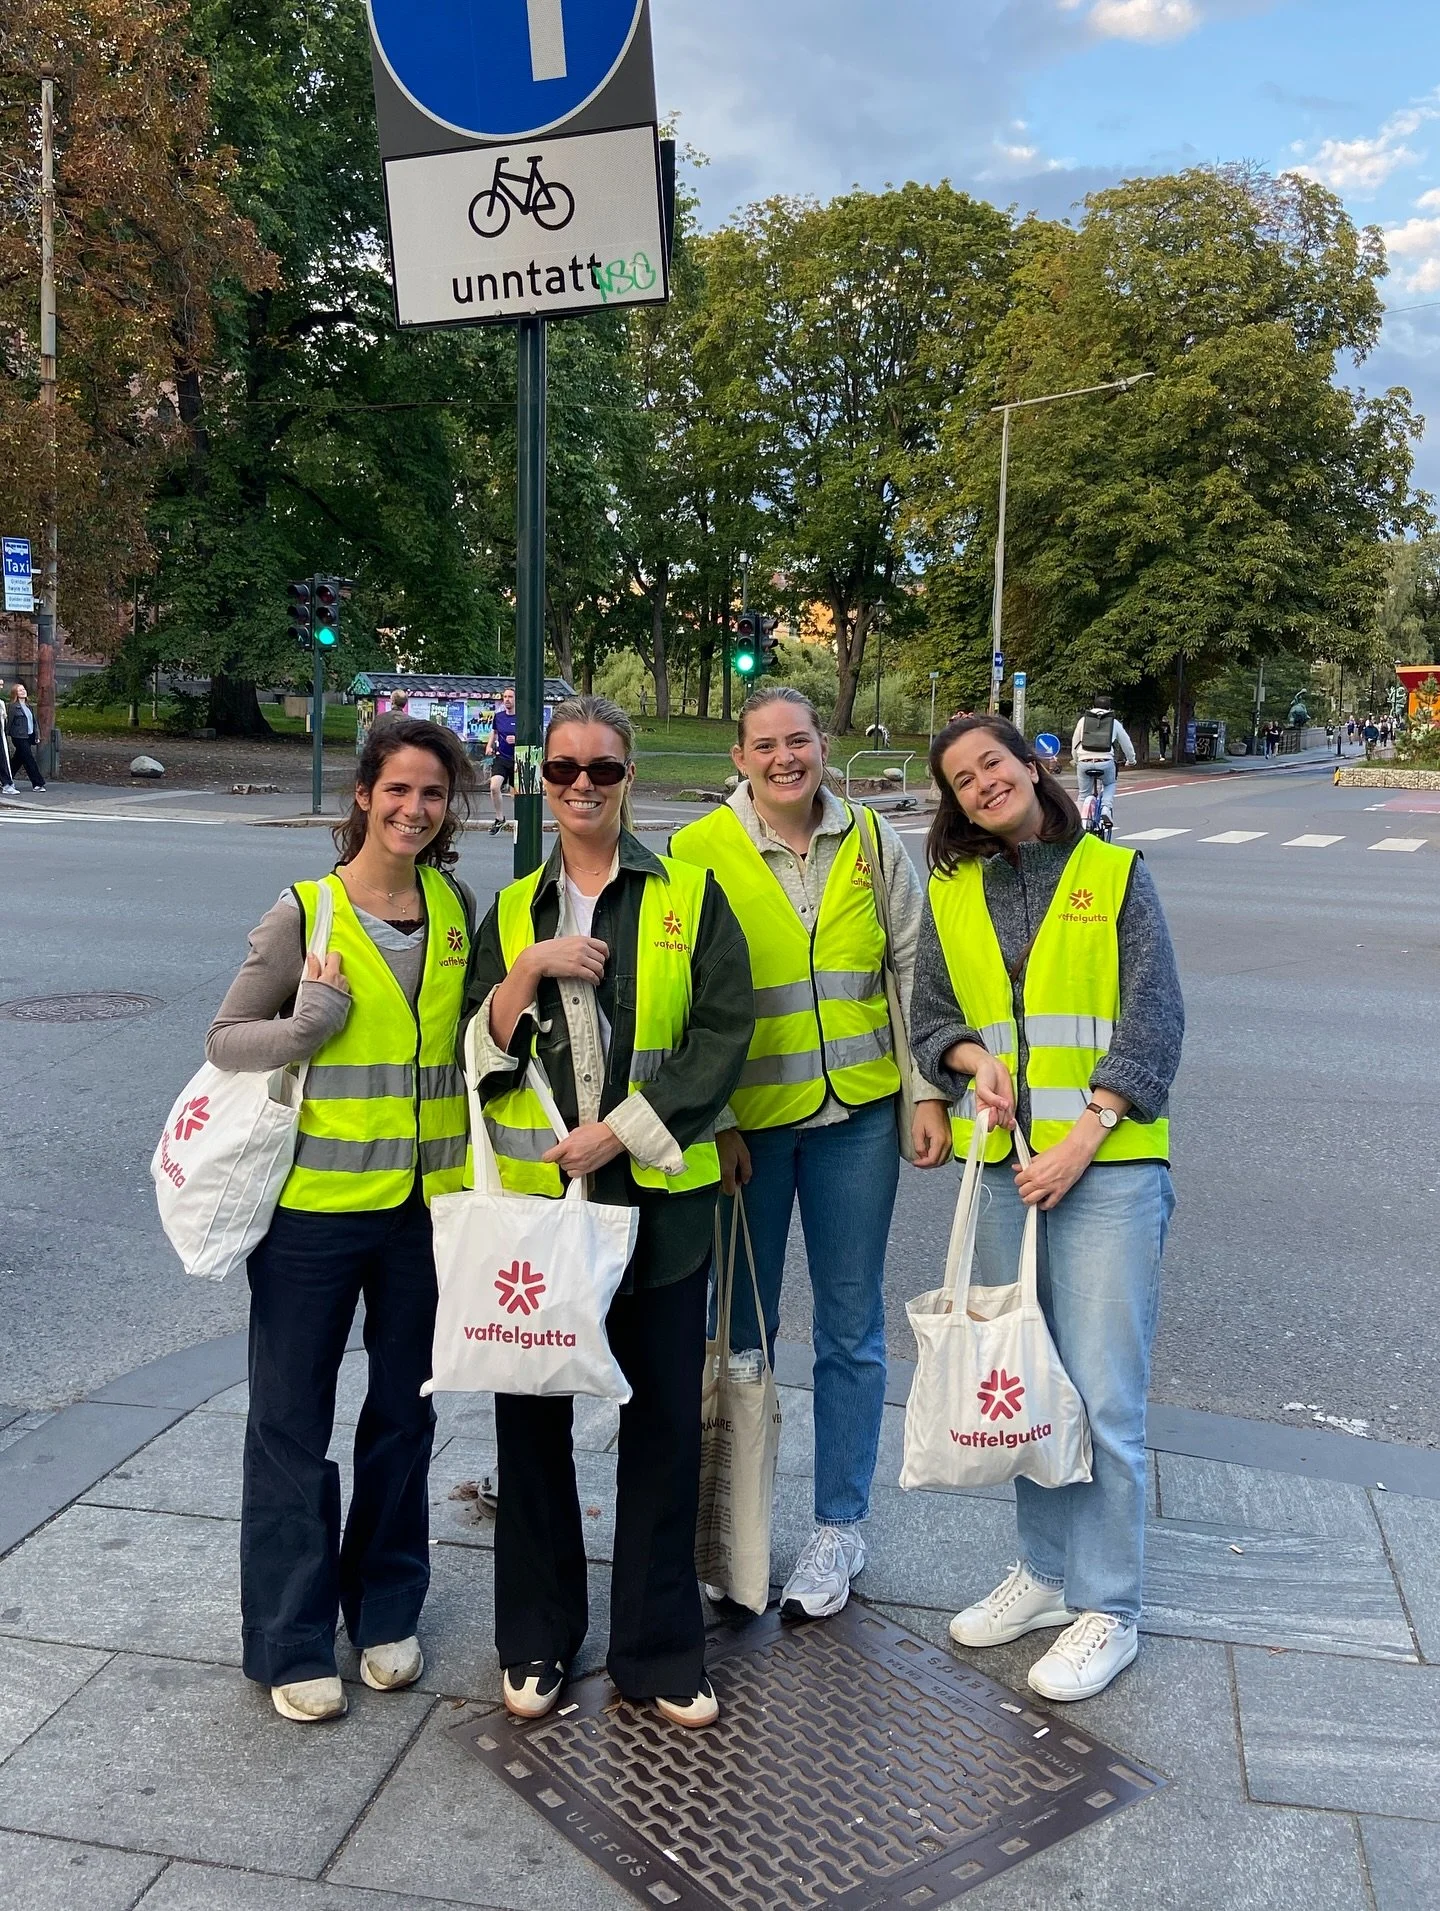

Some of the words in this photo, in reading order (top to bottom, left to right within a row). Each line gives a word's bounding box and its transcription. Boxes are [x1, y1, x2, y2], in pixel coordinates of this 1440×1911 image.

[452, 253, 601, 303] unntatt
[6, 559, 29, 573] Taxi
[463, 1322, 577, 1350] vaffelgutta
[949, 1423, 1052, 1449] vaffelgutta
